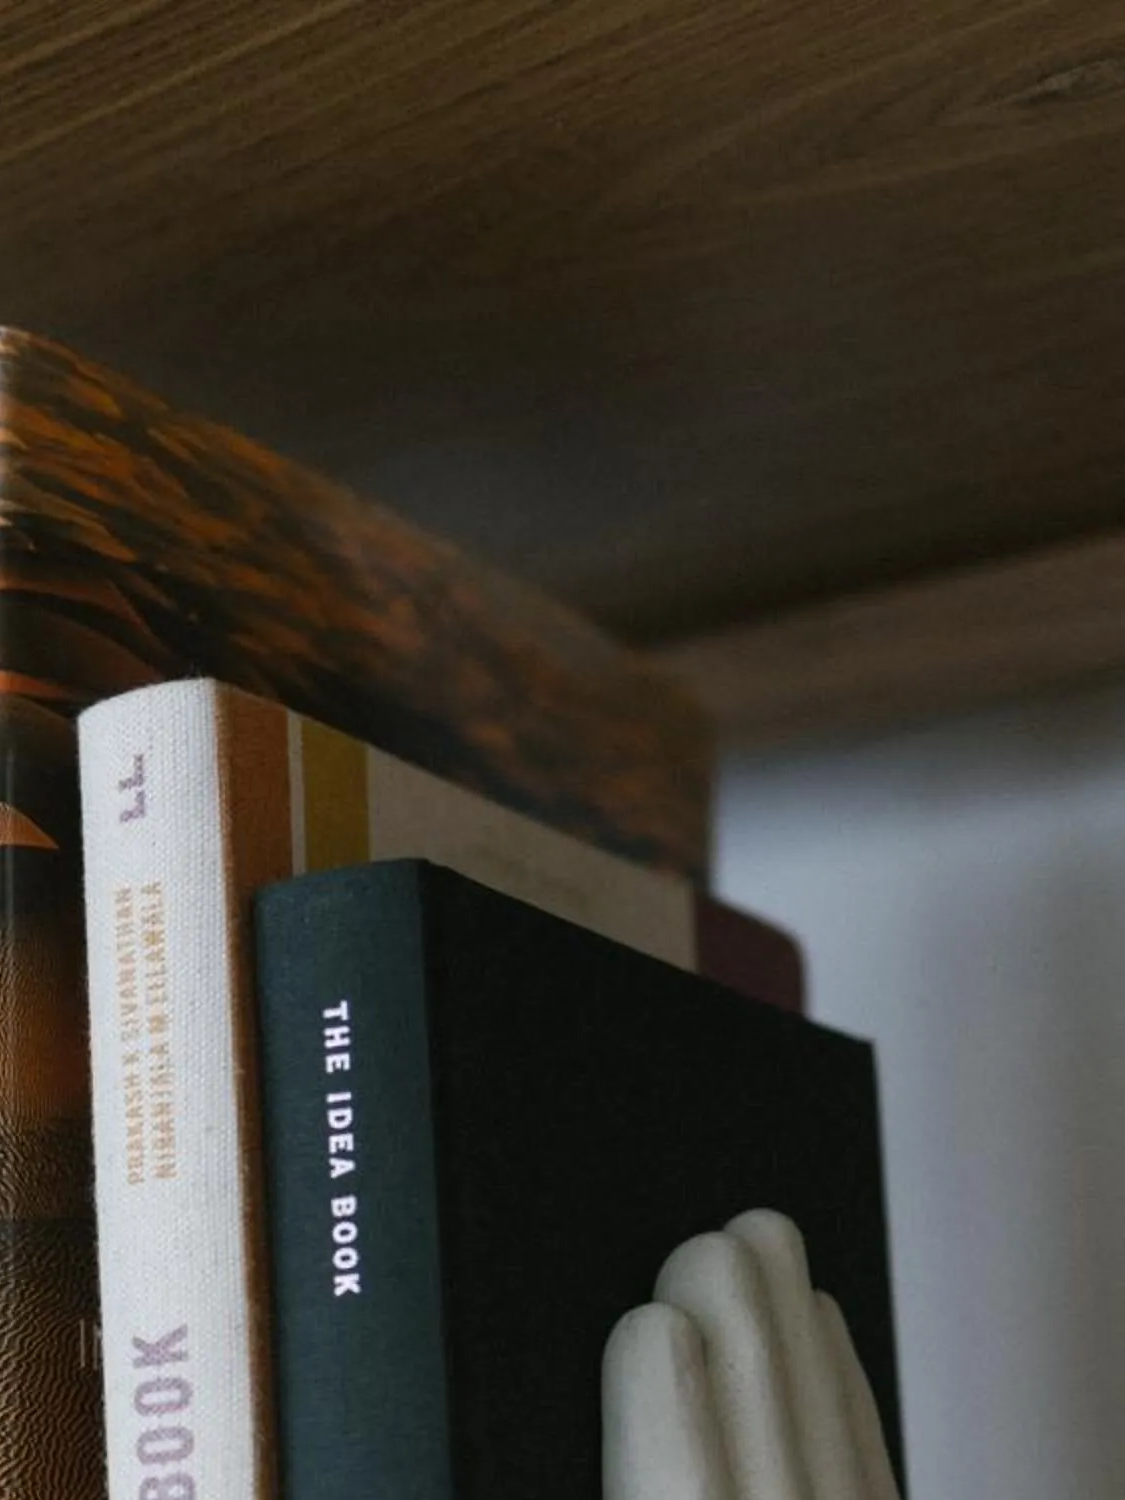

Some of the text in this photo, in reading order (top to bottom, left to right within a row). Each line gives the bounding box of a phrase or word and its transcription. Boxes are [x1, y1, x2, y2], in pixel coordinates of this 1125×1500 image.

[323, 1000, 361, 1296] THE IDEA BOOK
